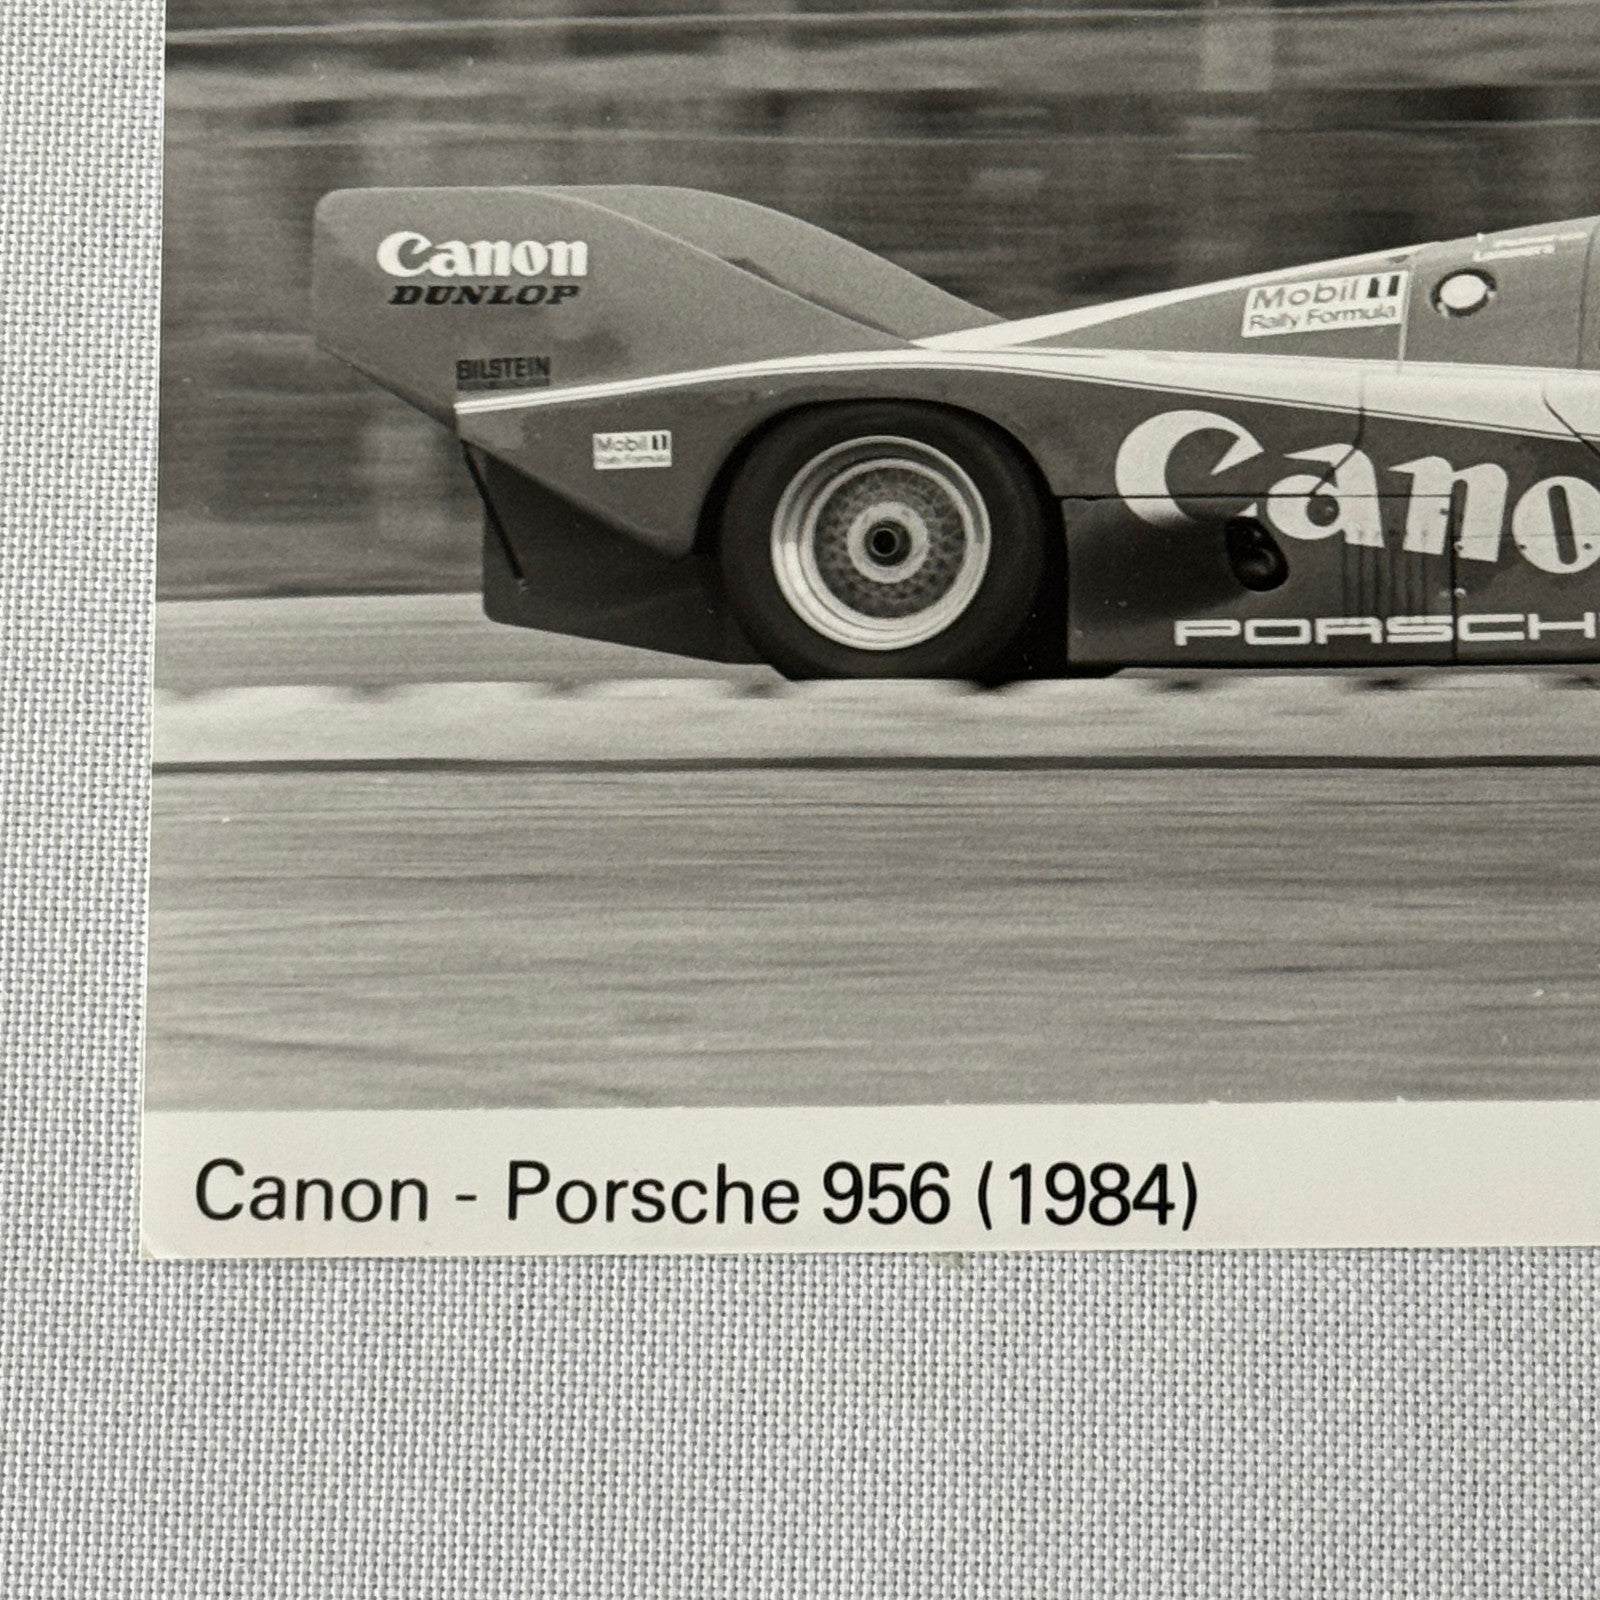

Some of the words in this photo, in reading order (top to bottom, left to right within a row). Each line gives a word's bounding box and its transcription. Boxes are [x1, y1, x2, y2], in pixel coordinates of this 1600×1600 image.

[376, 230, 589, 278] Canon
[387, 284, 581, 307] DUNLOP
[1252, 278, 1360, 310] Mobil
[1249, 311, 1299, 332] Rally
[1306, 302, 1397, 325] Formula
[455, 355, 550, 380] BILSTEIN
[595, 434, 649, 453] Mobil
[1174, 611, 1600, 646] PORSCH
[195, 1156, 428, 1222] Canon
[507, 1160, 800, 1225] Porsche
[823, 1160, 951, 1226] 956
[977, 1160, 1198, 1232] (1984)
